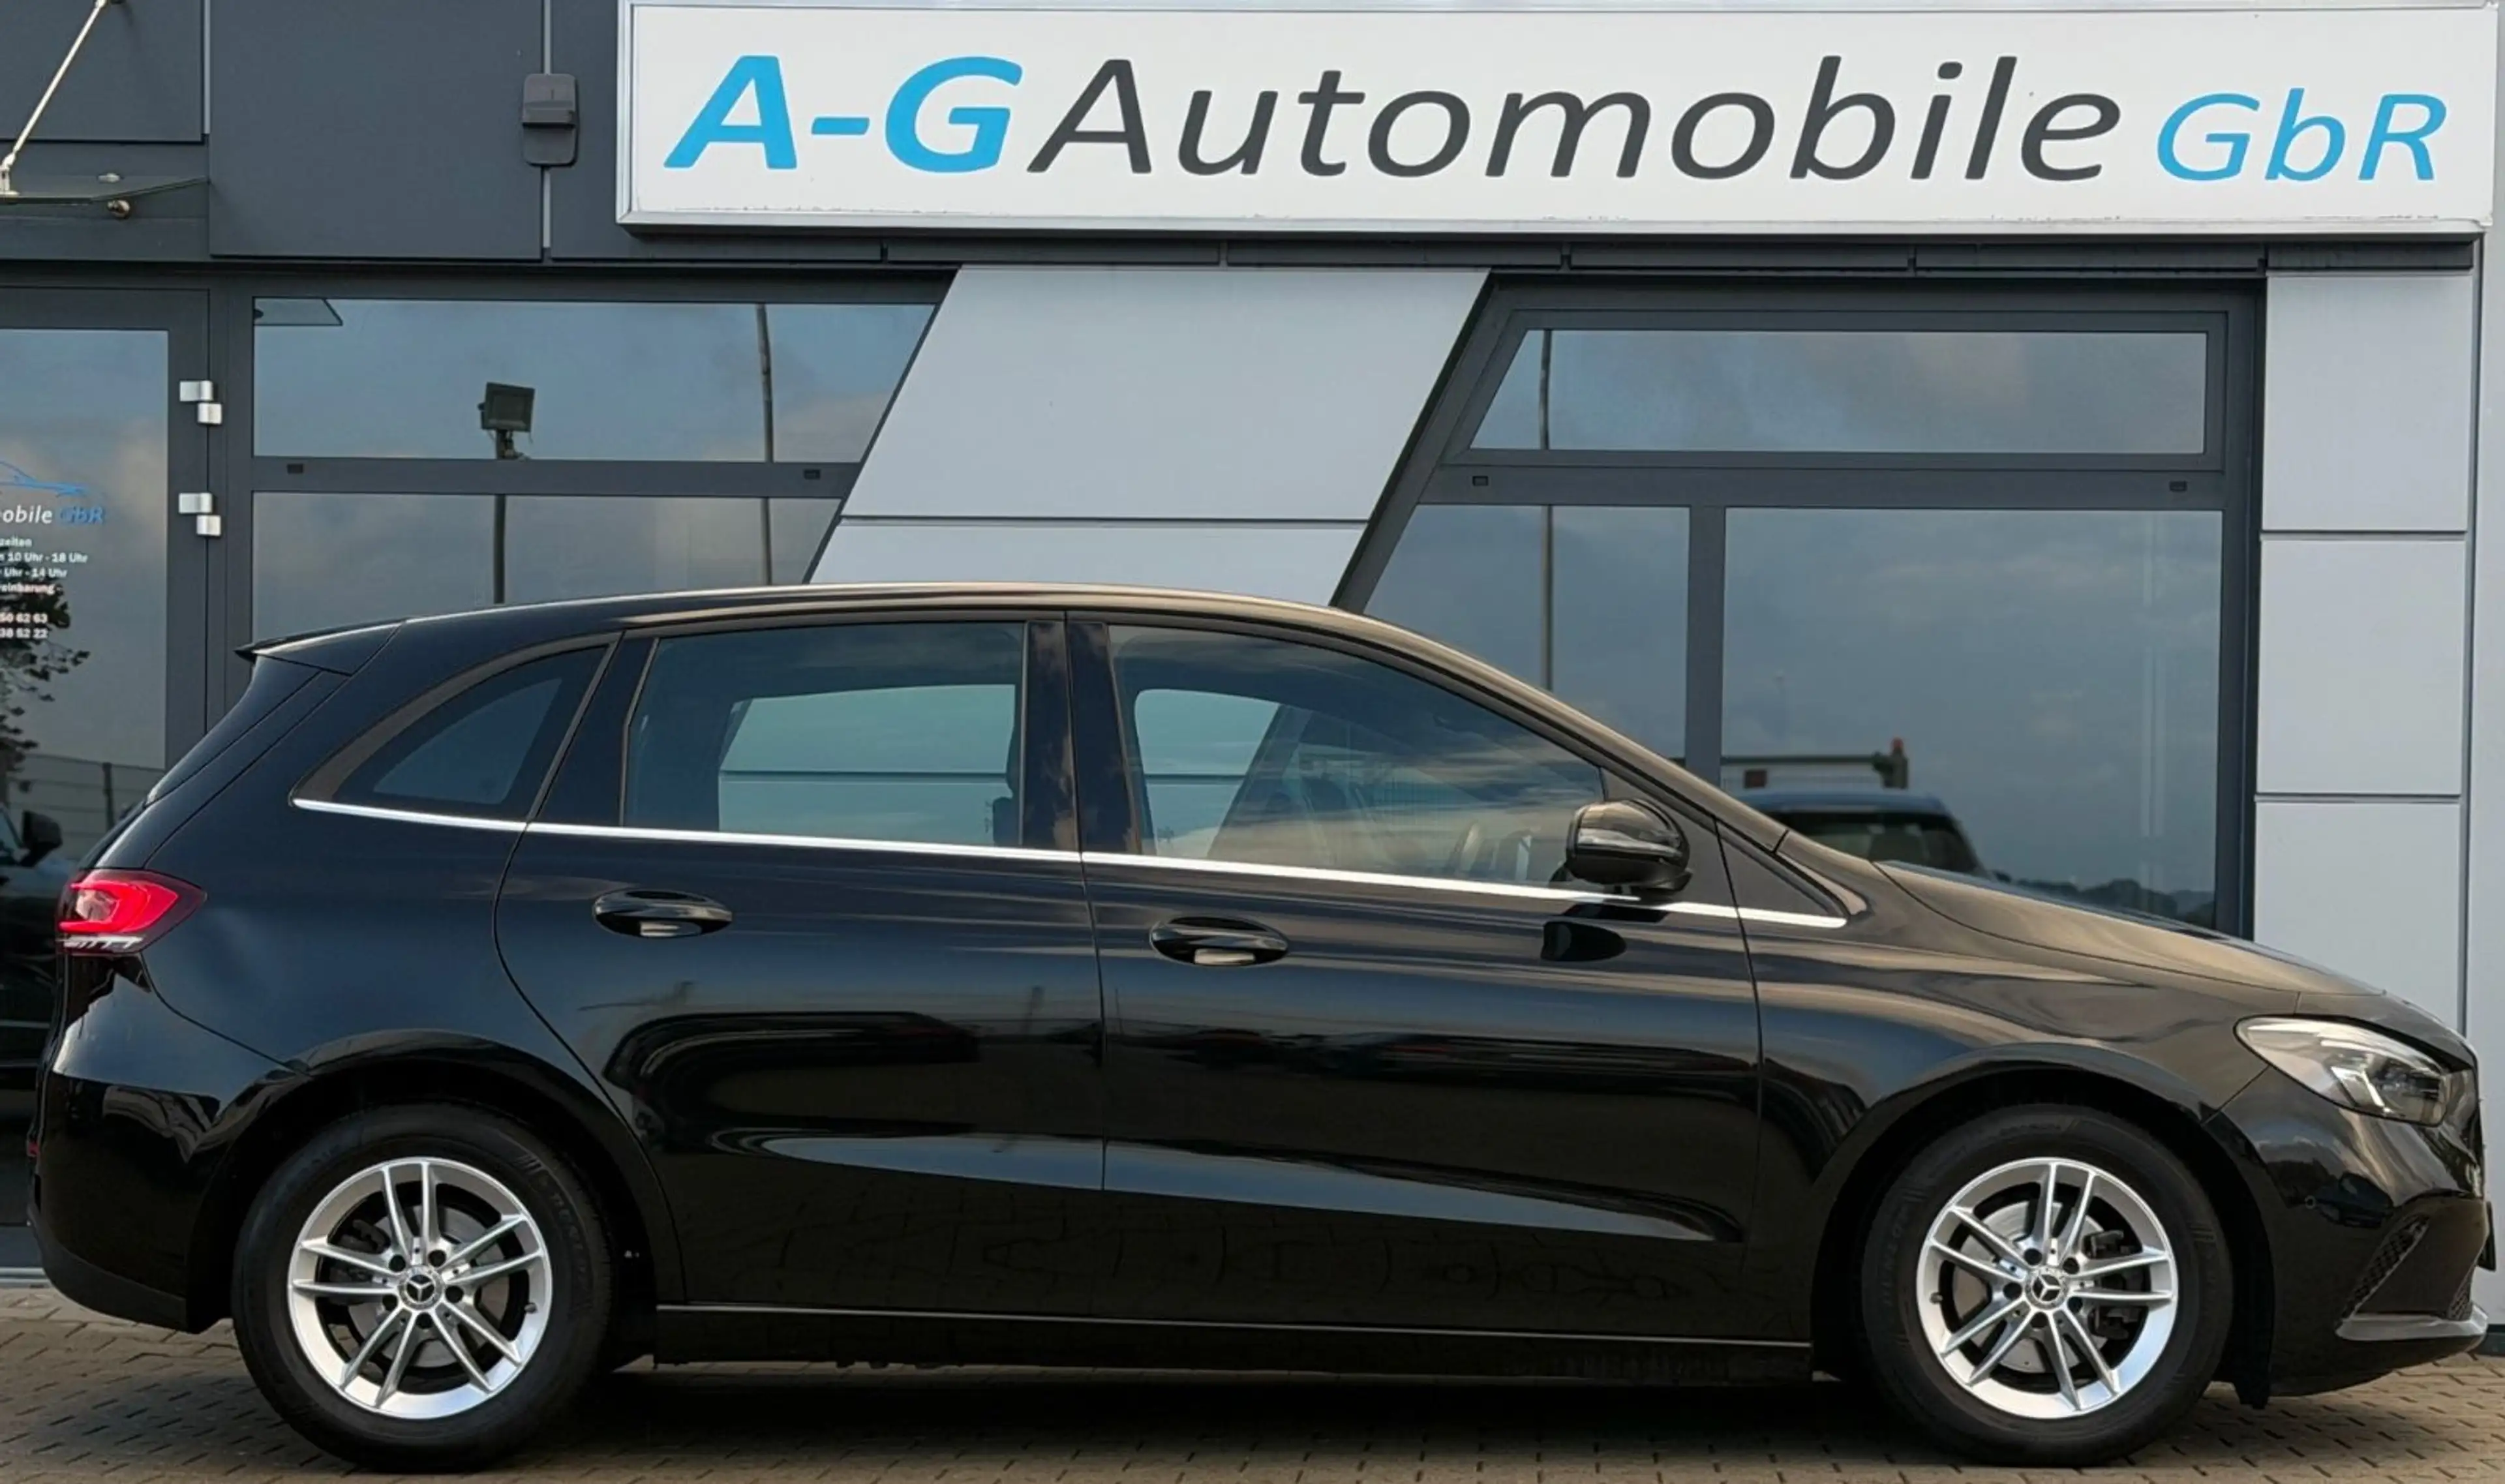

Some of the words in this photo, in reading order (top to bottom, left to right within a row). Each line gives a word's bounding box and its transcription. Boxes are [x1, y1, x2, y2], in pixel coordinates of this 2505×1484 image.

[664, 54, 1024, 174] A-G
[1027, 55, 2121, 181] Automobile
[2157, 87, 2447, 182] GbR
[0, 504, 53, 524] obile
[8, 552, 22, 562] 10
[24, 552, 44, 562] Uhr
[52, 552, 66, 562] 18
[68, 552, 88, 562] Uhr
[4, 567, 23, 577] Uhr
[48, 568, 68, 577] Uhr
